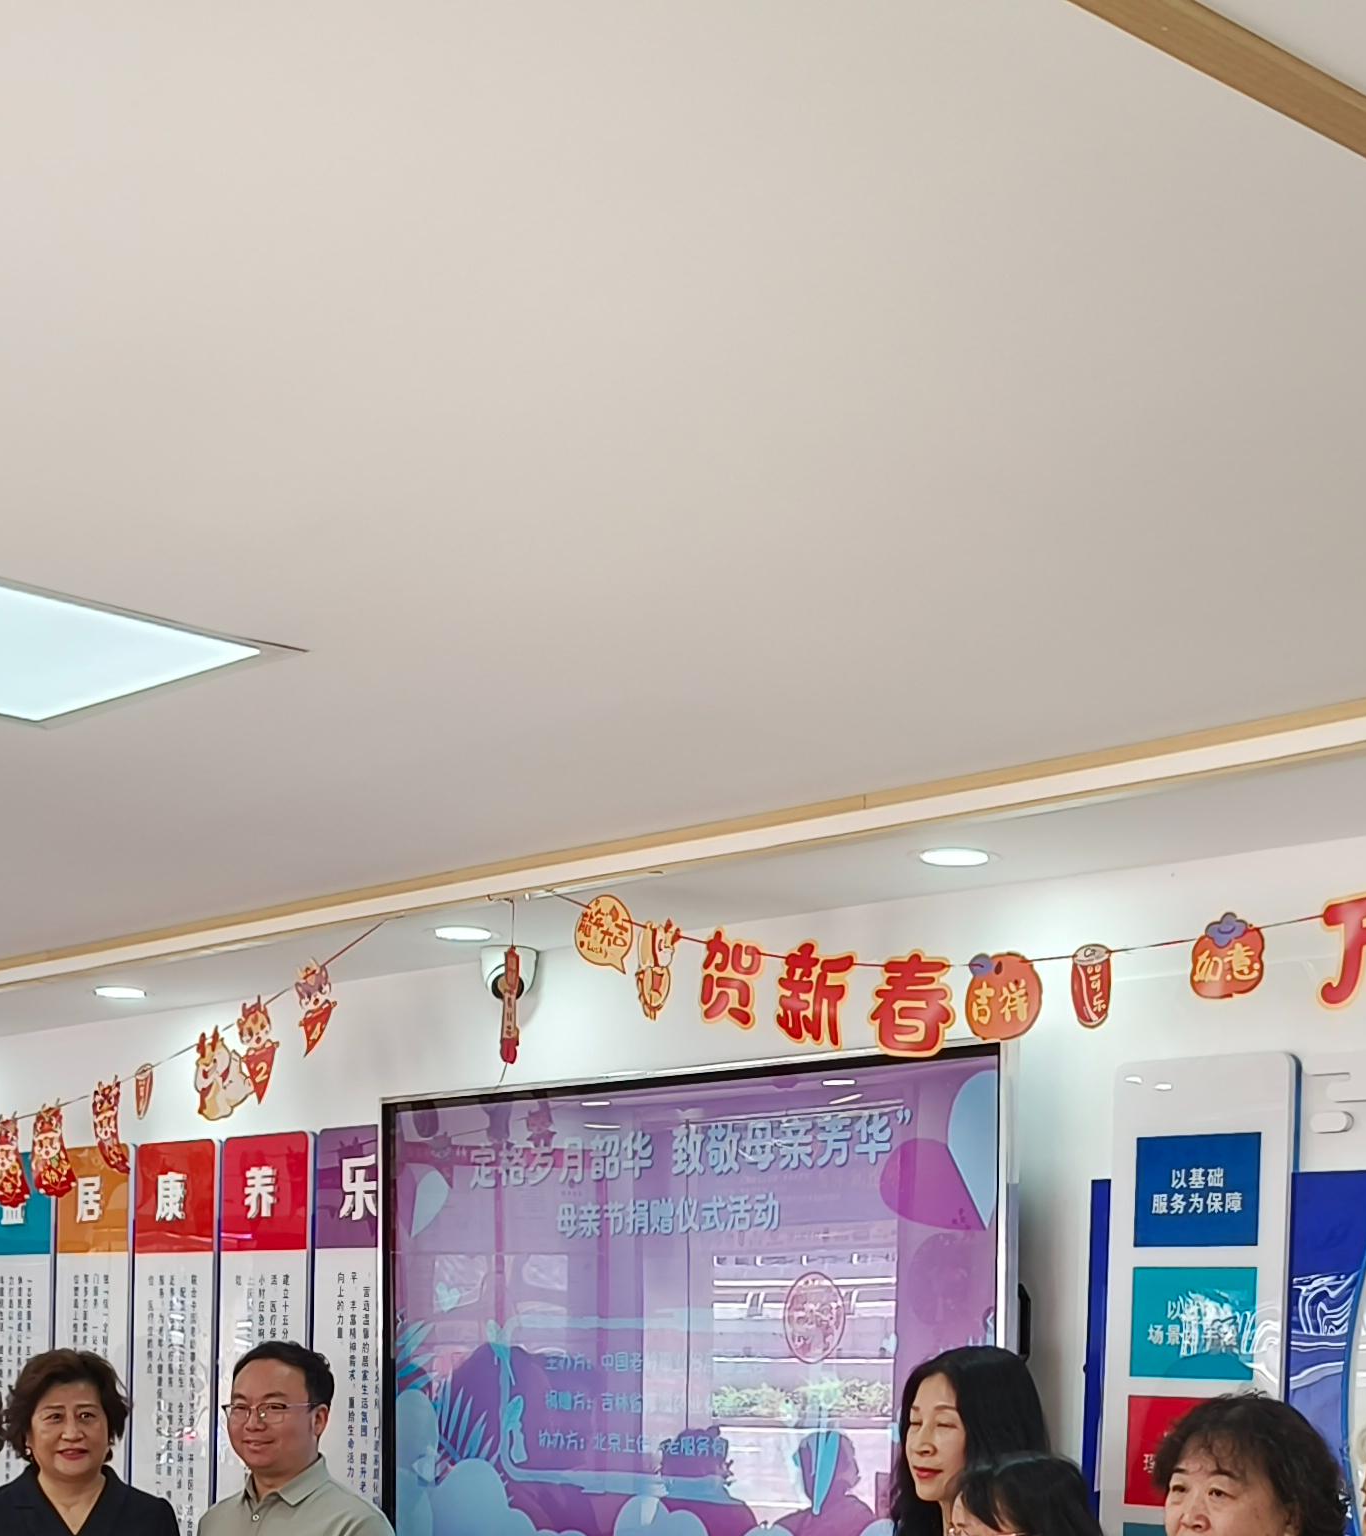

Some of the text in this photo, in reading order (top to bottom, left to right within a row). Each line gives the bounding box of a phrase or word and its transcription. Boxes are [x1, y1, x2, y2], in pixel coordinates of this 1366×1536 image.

[1193, 943, 1260, 983] 如意
[700, 930, 952, 1052] 贺新春
[972, 979, 1028, 1025] 吉祥
[310, 1021, 322, 1041] 4
[255, 1061, 268, 1083] 2
[76, 1175, 103, 1223] 居
[154, 1172, 187, 1223] 康
[244, 1166, 278, 1222] 养
[339, 1153, 378, 1224] 乐
[1170, 1167, 1224, 1189] 以基础
[555, 1191, 782, 1240] 母亲节捐赠仪式活动
[1152, 1192, 1243, 1214] 服务为保障
